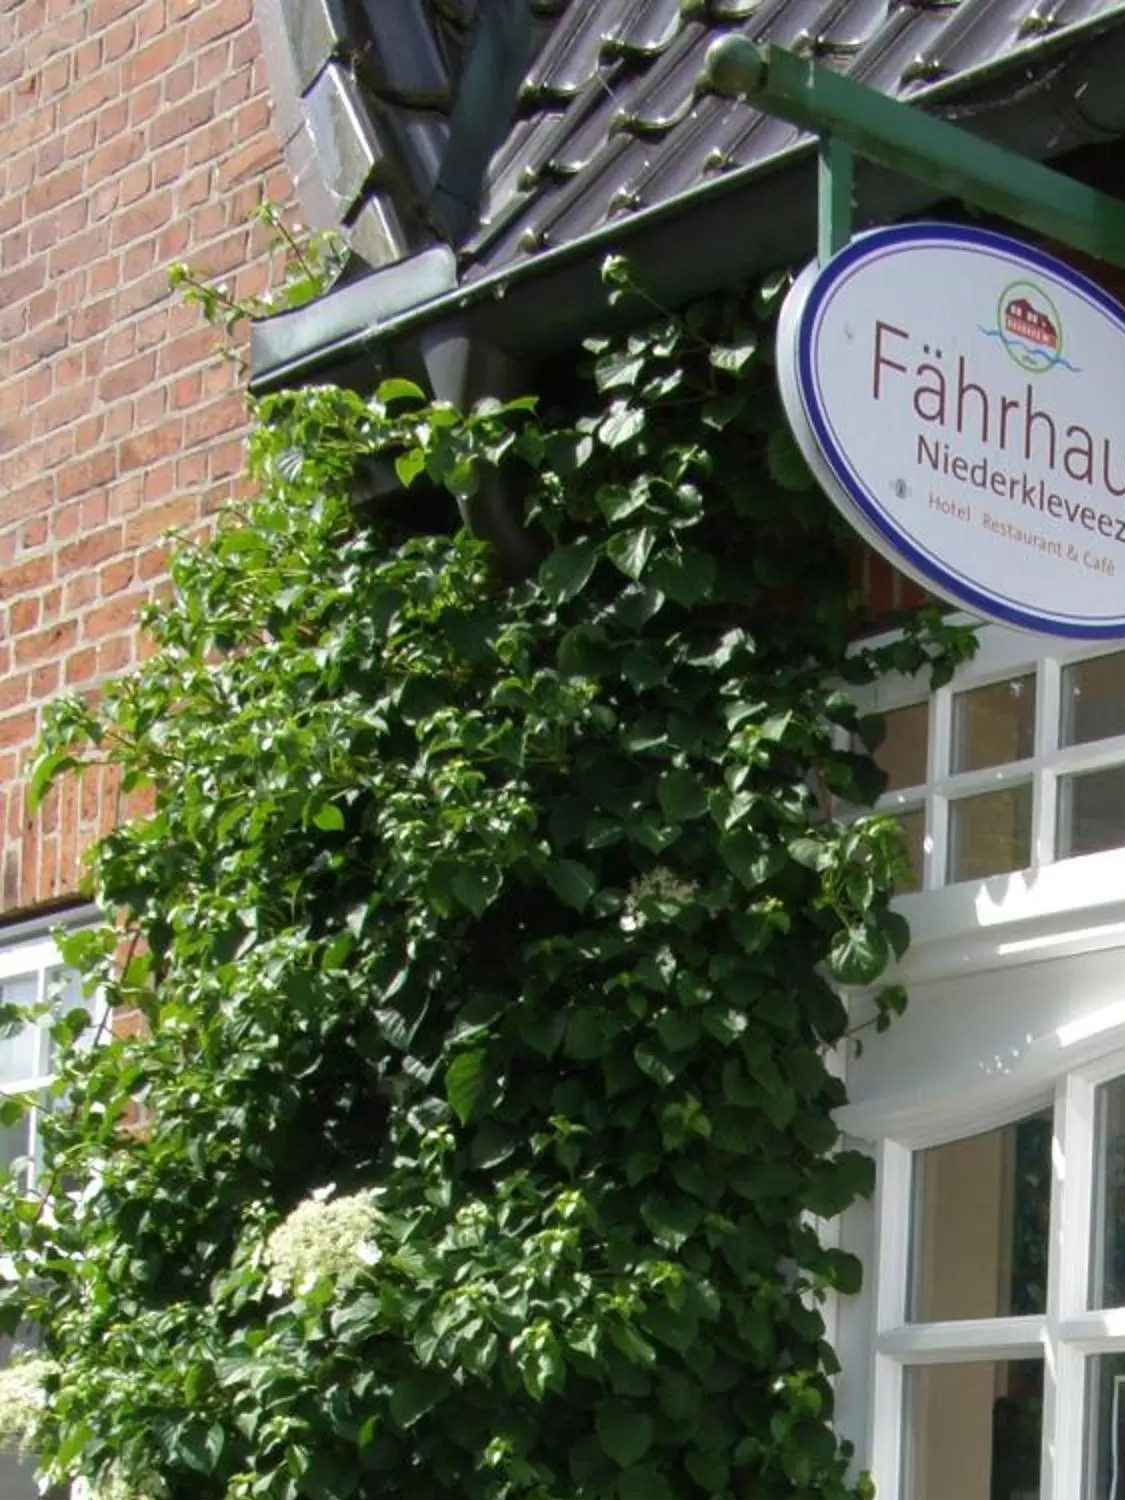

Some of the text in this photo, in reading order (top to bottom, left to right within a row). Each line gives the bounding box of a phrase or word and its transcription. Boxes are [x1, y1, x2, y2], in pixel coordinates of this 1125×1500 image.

[928, 493, 971, 521] Hotel
[982, 513, 1063, 557] Restaurant
[1066, 543, 1079, 561] &
